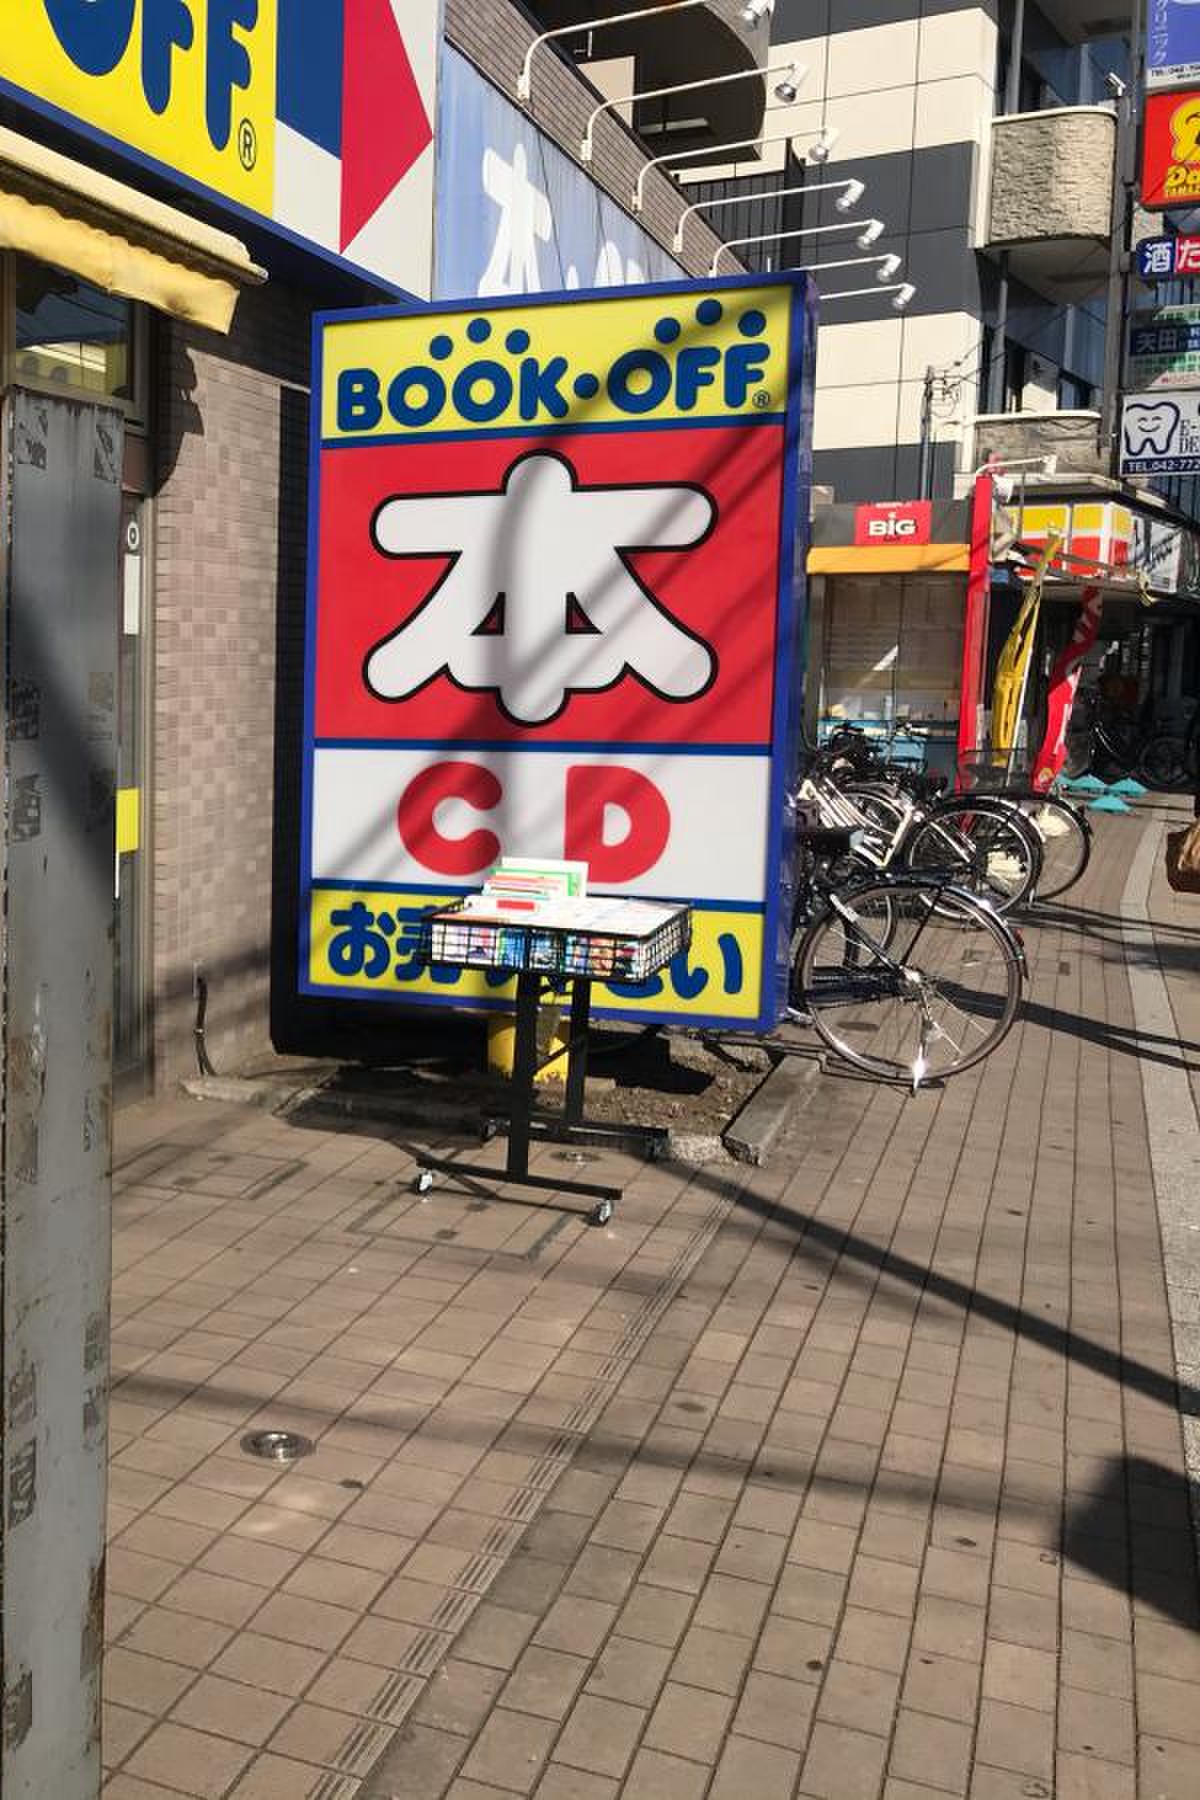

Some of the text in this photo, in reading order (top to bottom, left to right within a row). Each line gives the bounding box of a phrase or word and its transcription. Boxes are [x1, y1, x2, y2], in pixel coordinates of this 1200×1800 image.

[1144, 242, 1173, 273] 酒
[361, 448, 718, 725] 本
[397, 761, 671, 884] CD
